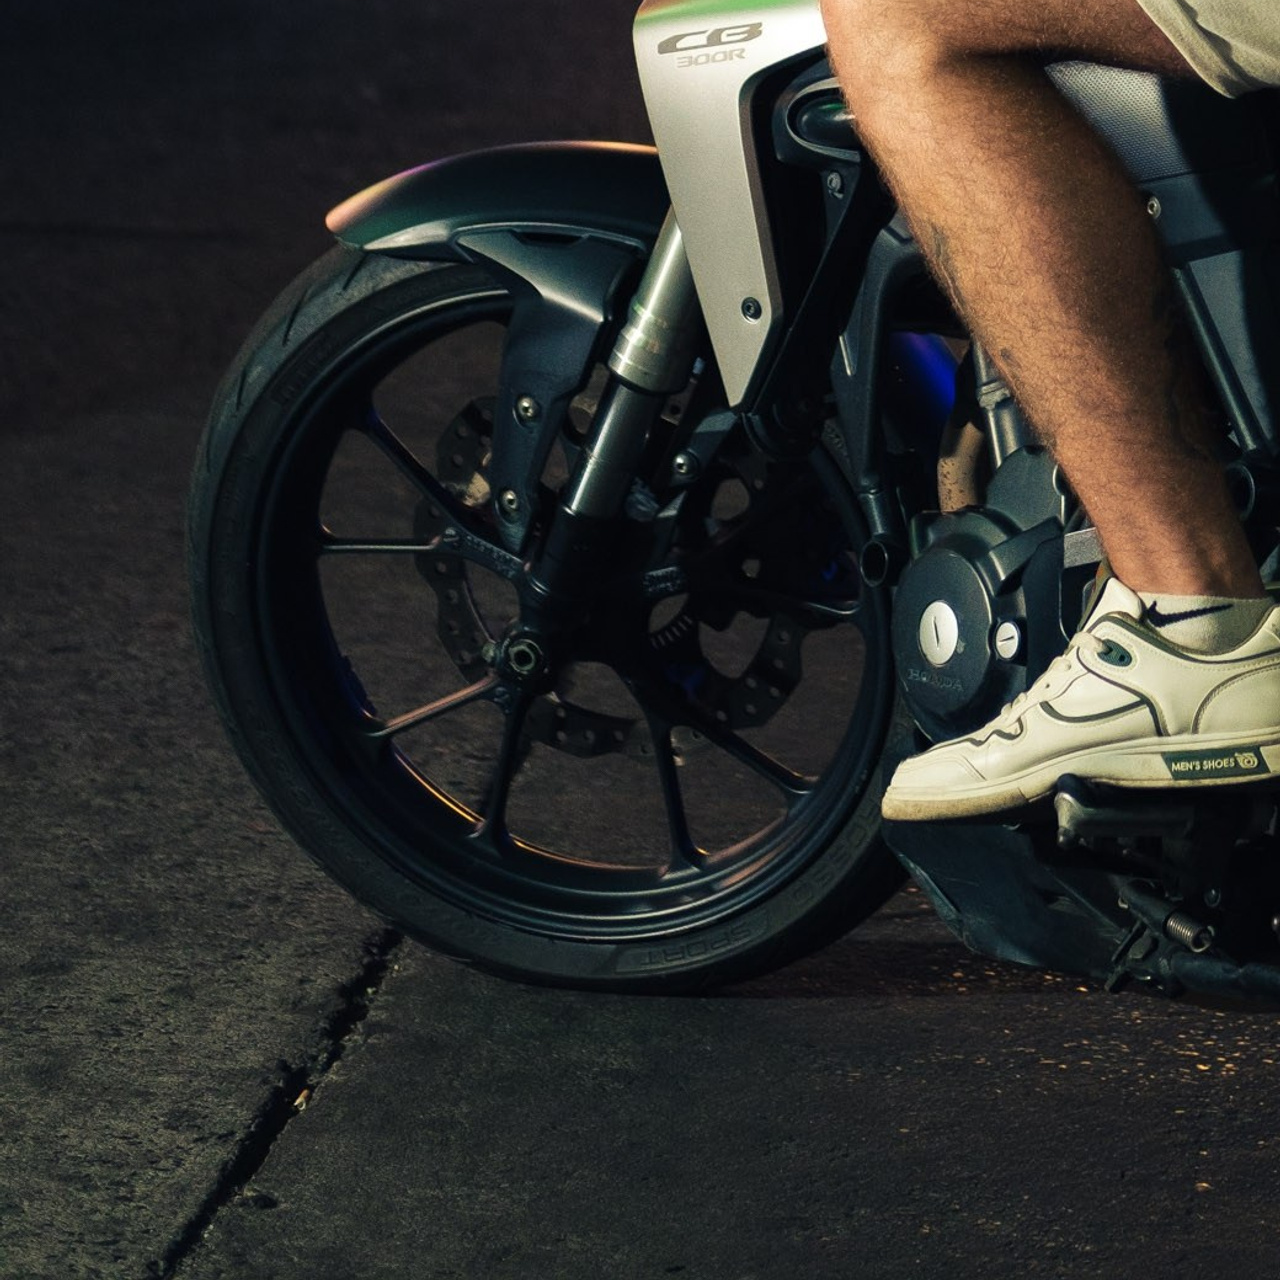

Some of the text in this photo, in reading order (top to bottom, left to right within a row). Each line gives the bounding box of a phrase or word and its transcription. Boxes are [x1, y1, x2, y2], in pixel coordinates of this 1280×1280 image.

[676, 47, 746, 69] 300R
[906, 668, 965, 692] HONDA
[1171, 757, 1236, 772] MEN'S SHOES
